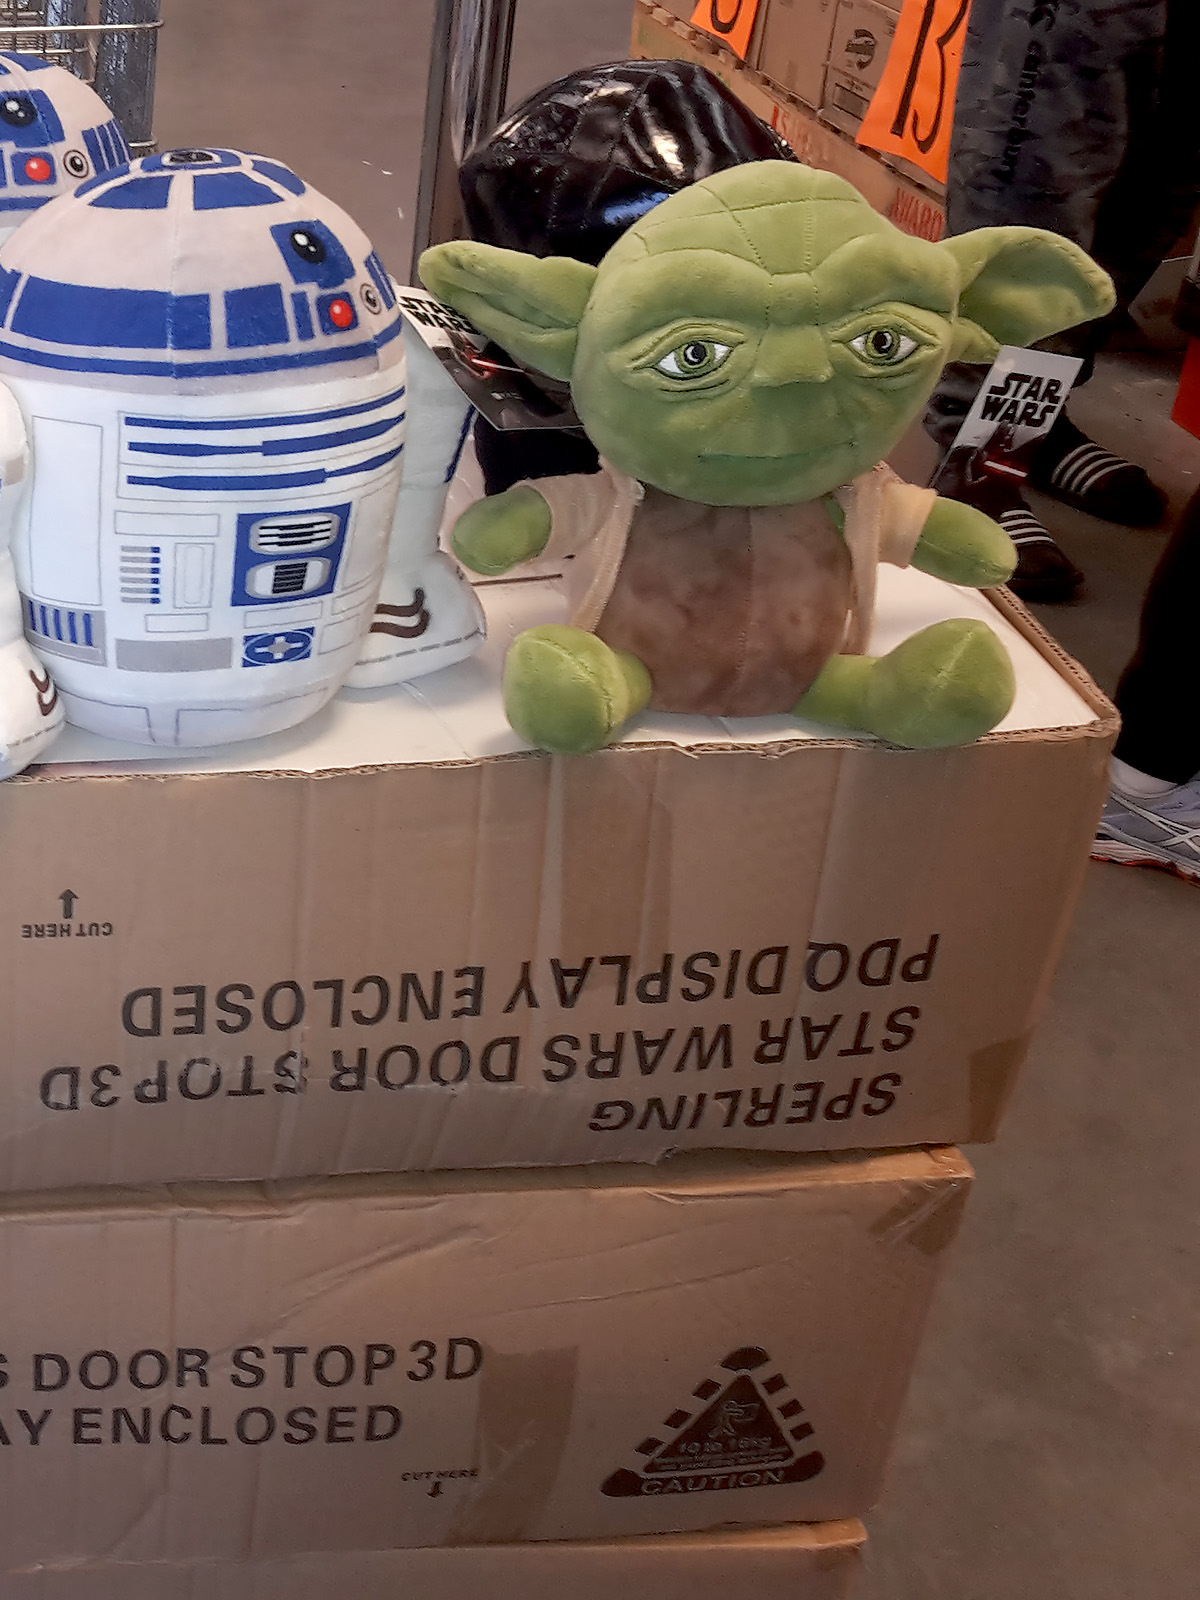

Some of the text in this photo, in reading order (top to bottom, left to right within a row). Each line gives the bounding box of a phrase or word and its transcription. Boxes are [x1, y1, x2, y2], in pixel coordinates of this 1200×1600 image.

[988, 373, 1063, 404] STAR
[981, 395, 1057, 427] WARS
[22, 922, 113, 938] CUT HERE
[122, 933, 941, 1038] PDQ DISPLAY ENCLOSED
[542, 1024, 733, 1083] WARS
[753, 1006, 921, 1065] STAR
[328, 1035, 520, 1092] DOOR
[588, 1073, 903, 1131] SPERLING
[32, 1348, 210, 1392] DOOR
[73, 1404, 402, 1444] ENCLOSED
[641, 1470, 785, 1495] CAUTION
